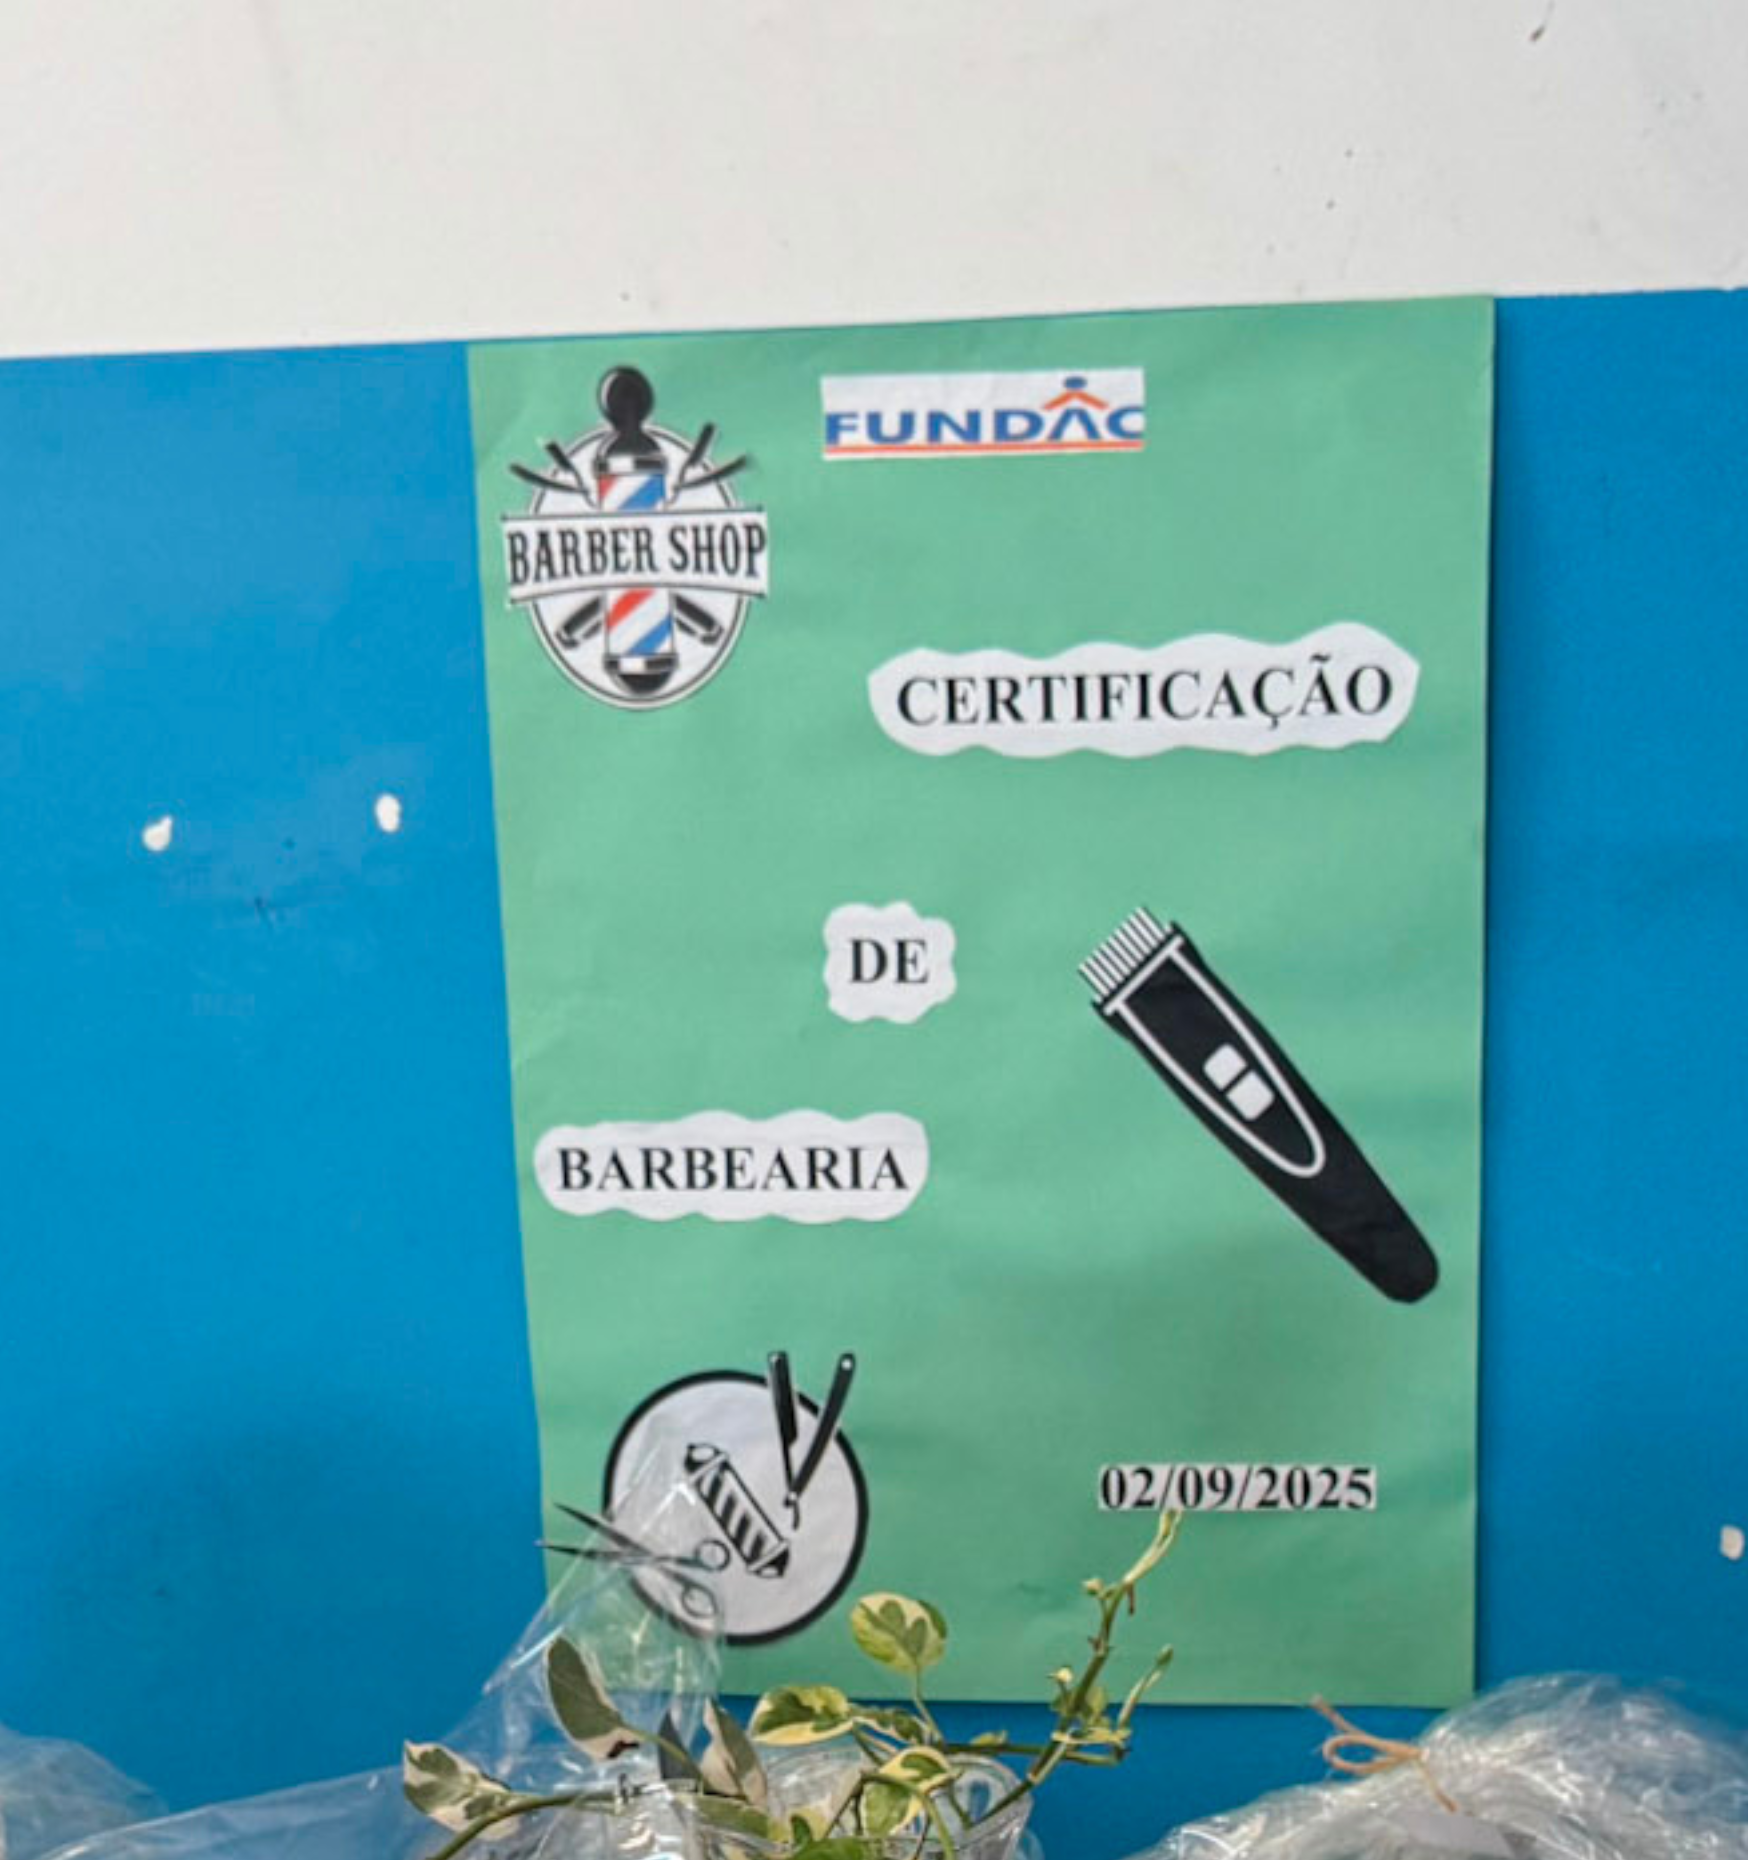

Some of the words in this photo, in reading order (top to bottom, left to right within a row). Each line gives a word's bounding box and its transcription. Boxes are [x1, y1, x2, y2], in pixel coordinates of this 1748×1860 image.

[507, 525, 659, 586] BARBER
[667, 522, 767, 578] SHOP
[896, 653, 1394, 729] CERTIFICAÇÃO
[849, 938, 930, 984] DE
[557, 1146, 909, 1191] BARBEARIA
[1101, 1465, 1373, 1510] 02/09/2025
